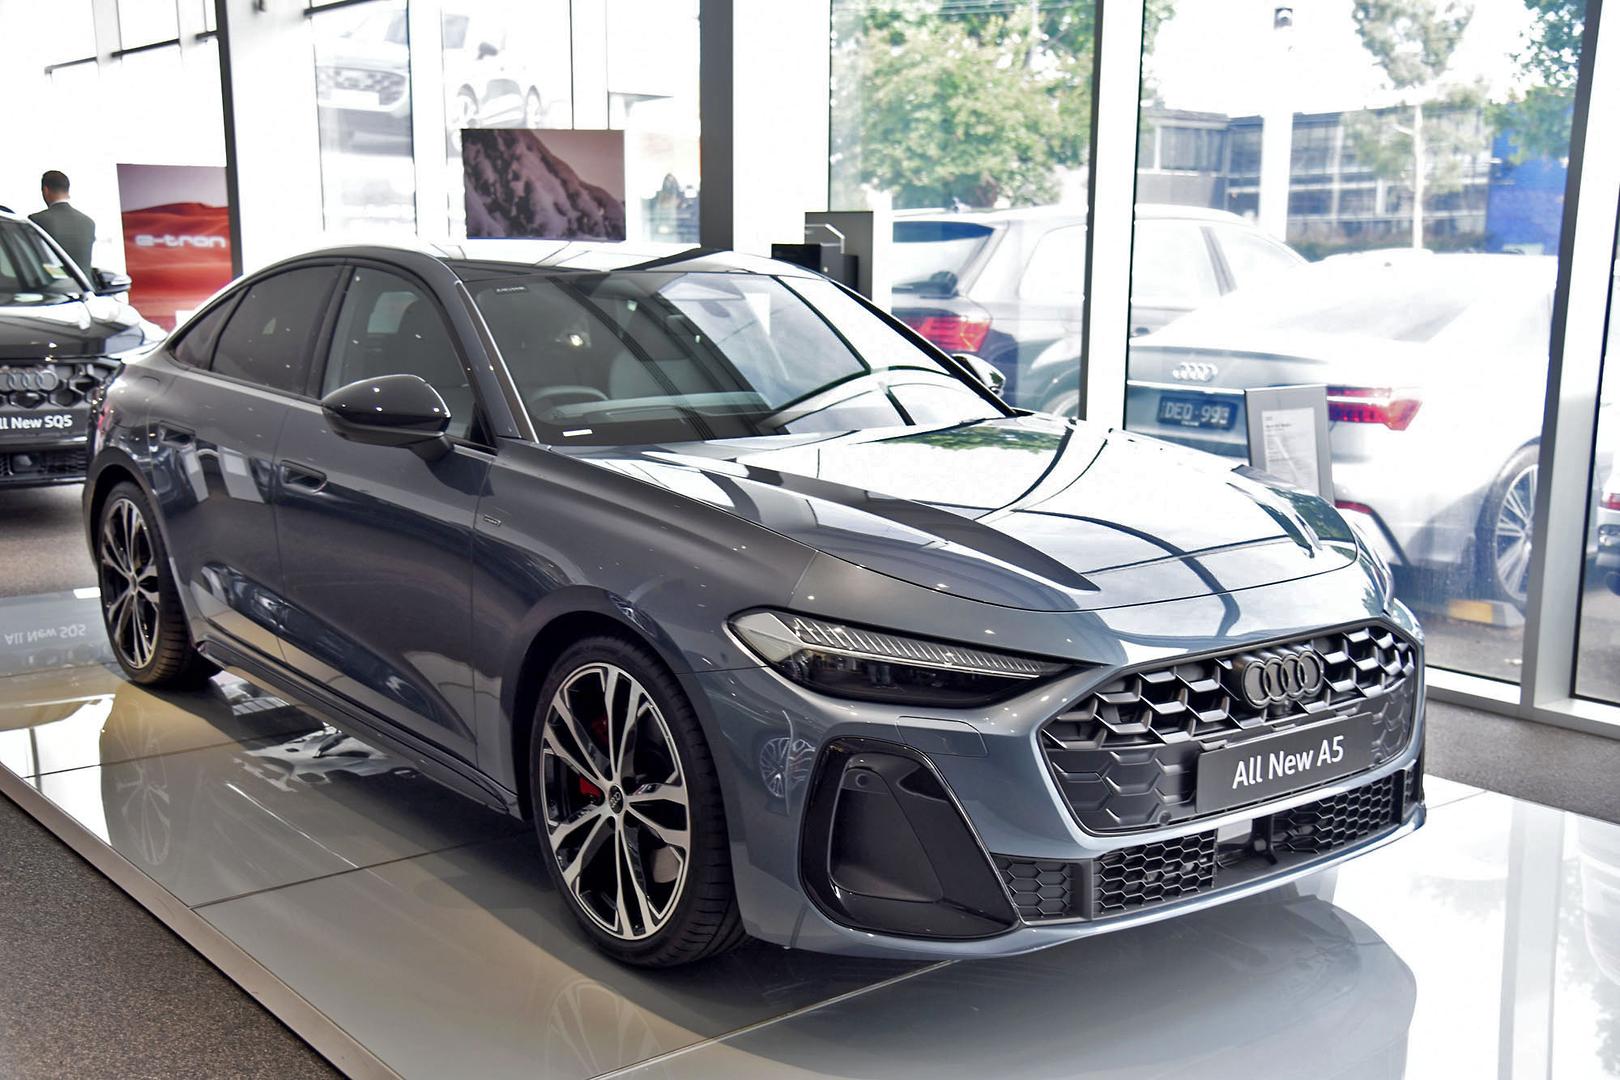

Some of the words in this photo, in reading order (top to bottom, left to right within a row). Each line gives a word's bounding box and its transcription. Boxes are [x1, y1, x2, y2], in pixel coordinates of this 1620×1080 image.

[135, 234, 226, 248] e-tron
[0, 417, 9, 430] ll
[11, 417, 42, 429] New
[44, 414, 73, 429] SQ5
[1232, 755, 1263, 789] All
[1268, 749, 1314, 780] New
[1316, 735, 1344, 767] A5
